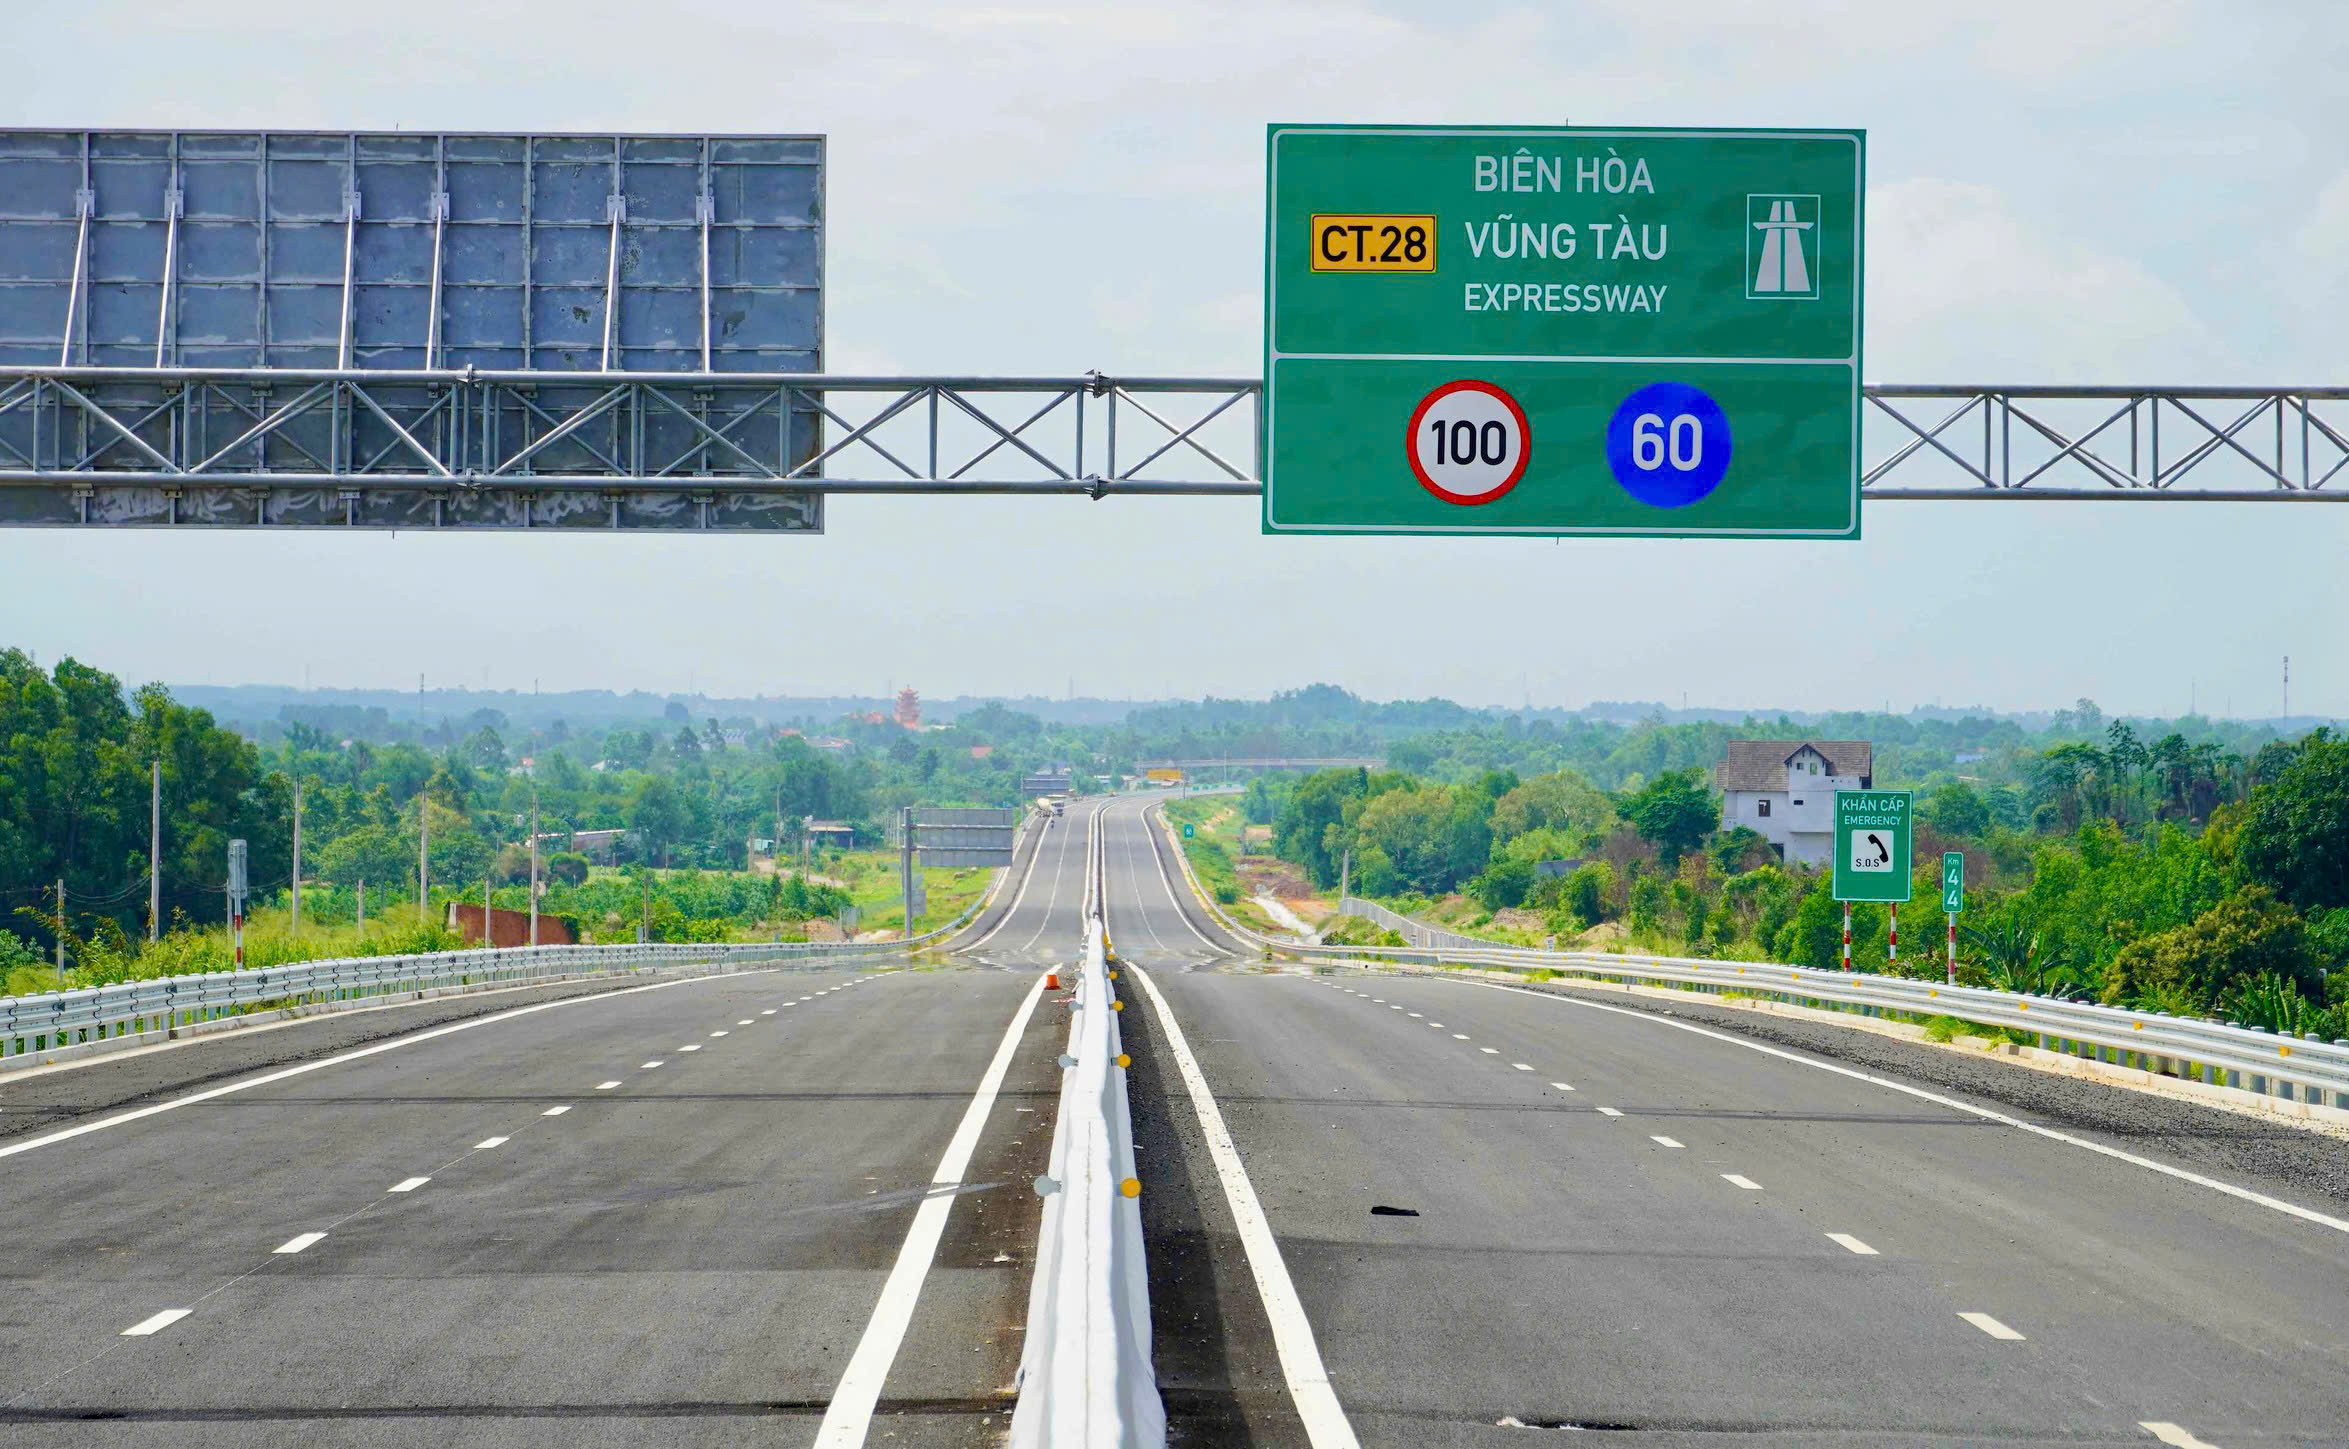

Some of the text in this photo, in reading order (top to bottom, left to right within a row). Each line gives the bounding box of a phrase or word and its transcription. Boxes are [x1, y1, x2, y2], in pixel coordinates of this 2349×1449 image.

[1475, 148, 1656, 194] BIÊN HÒA
[1321, 225, 1427, 263] CT.28
[1465, 213, 1667, 261] VŨNG TÀU
[1464, 283, 1668, 313] EXPRESSWAY
[1431, 419, 1507, 466] 100
[1632, 413, 1703, 471] 60
[1842, 794, 1904, 811] KHẨN CẤP
[1844, 815, 1902, 825] EMERGENCY
